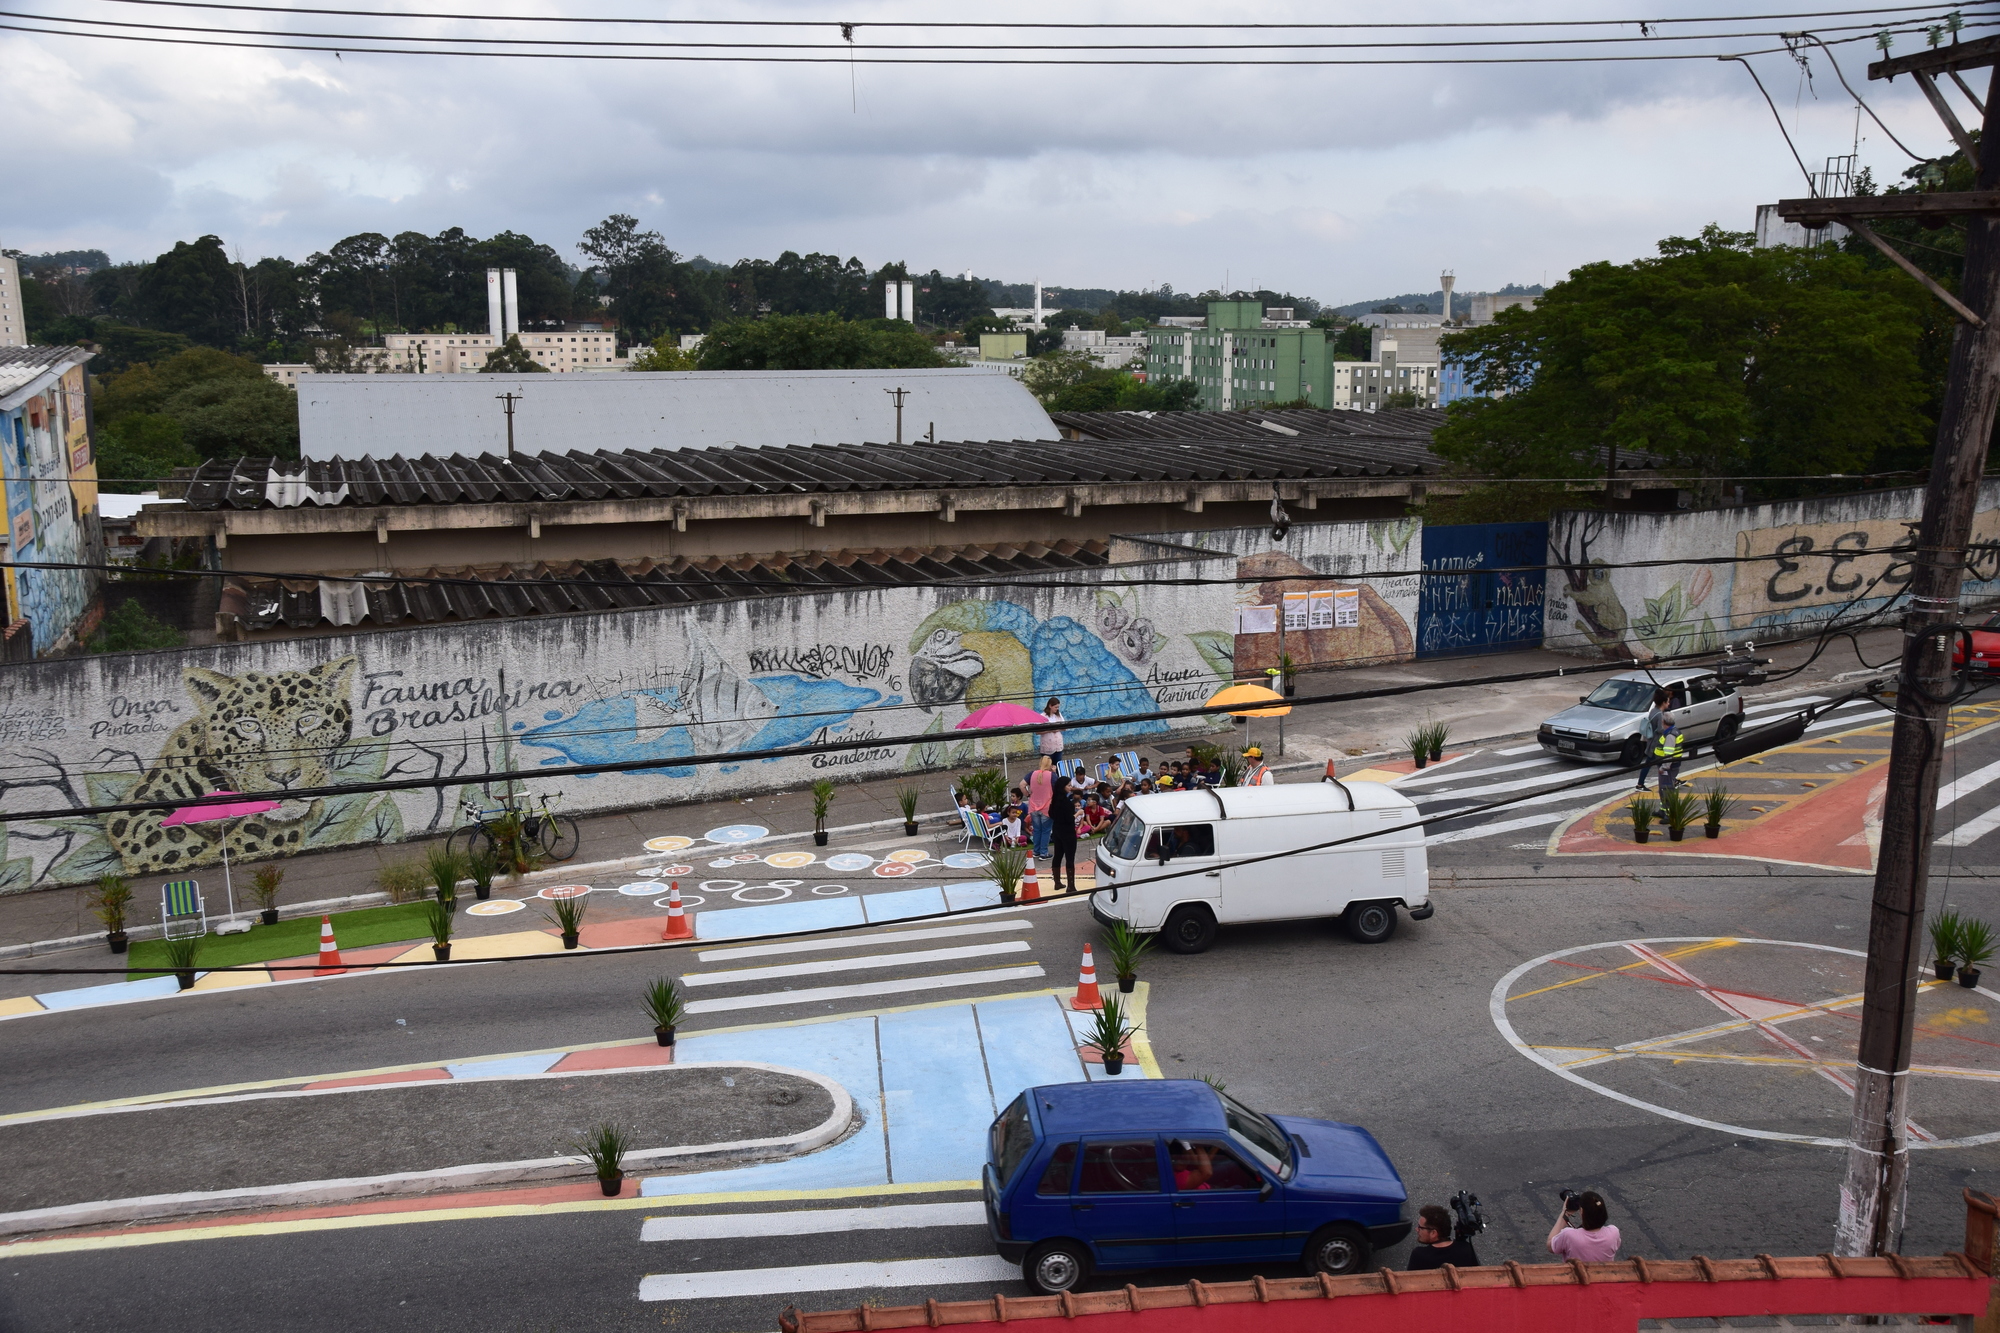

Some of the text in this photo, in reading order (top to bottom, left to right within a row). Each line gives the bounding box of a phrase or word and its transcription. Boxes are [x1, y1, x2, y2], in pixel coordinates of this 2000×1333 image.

[1146, 662, 1204, 685] Arara
[362, 670, 486, 709] Fauna
[1156, 682, 1210, 703] Canindé
[108, 695, 180, 722] Onça
[365, 679, 584, 736] Brasileira
[90, 720, 169, 739] Pintada
[811, 747, 896, 769] Bandeira
